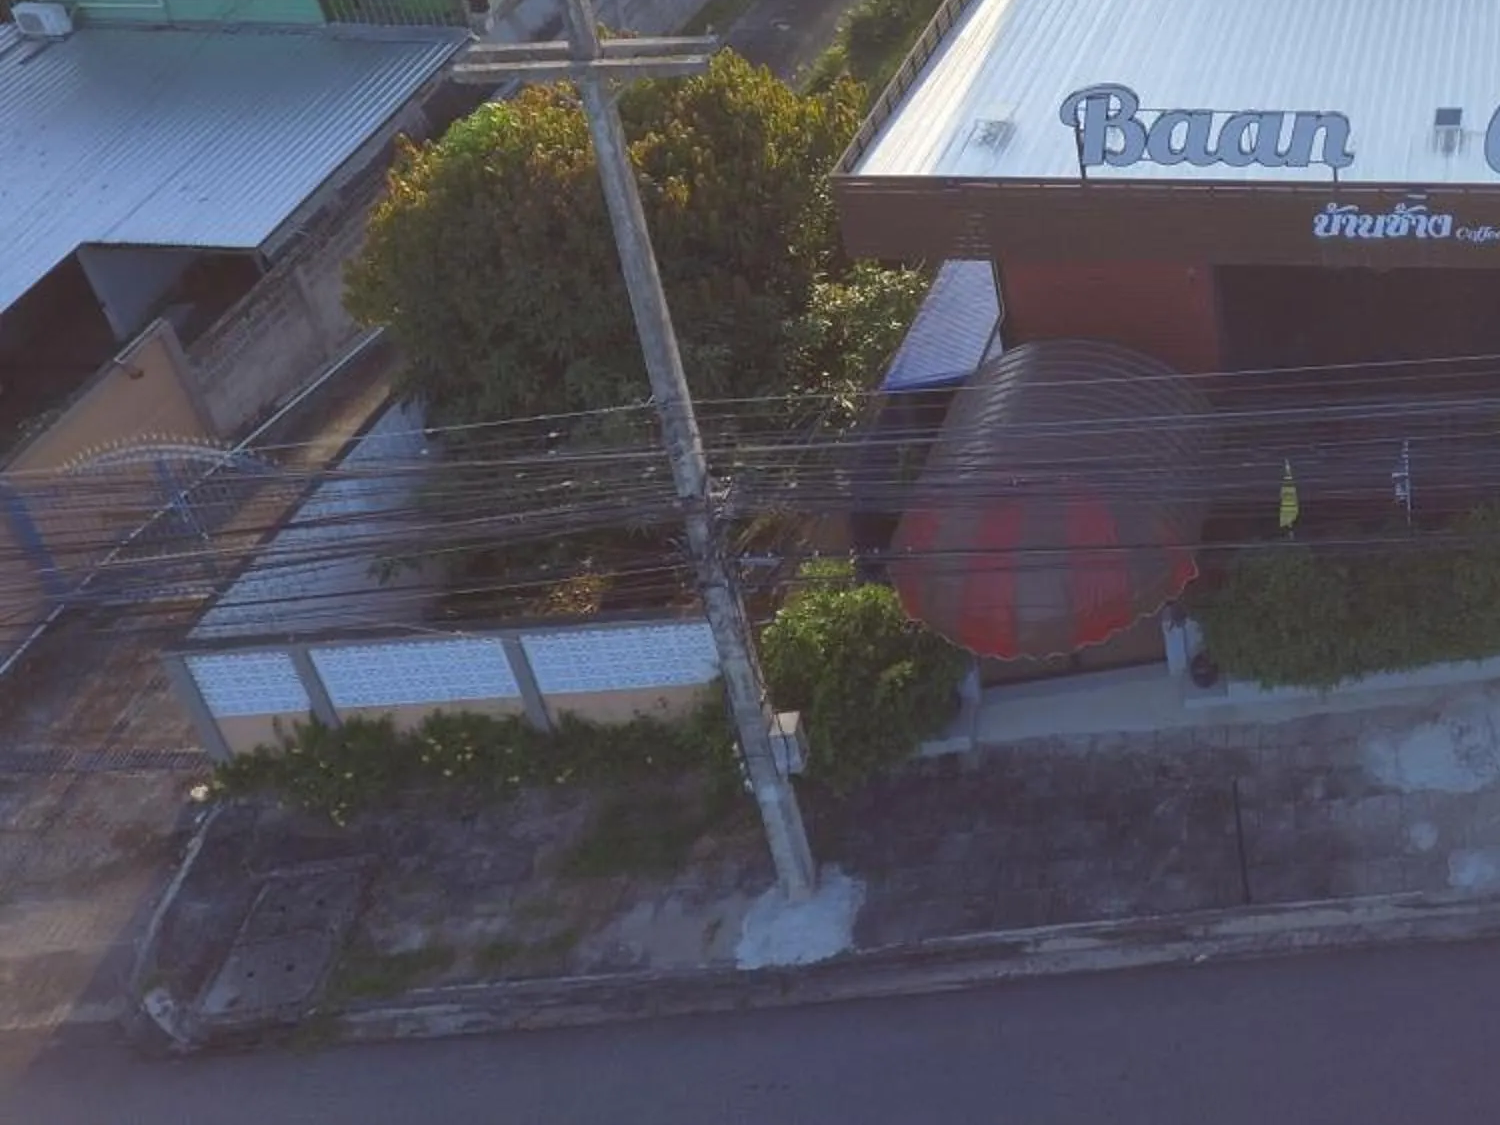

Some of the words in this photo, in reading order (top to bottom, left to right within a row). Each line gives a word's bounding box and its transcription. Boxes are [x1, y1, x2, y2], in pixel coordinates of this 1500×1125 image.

[1060, 82, 1354, 167] Baan
[1313, 202, 1452, 239] บ้านช้าง
